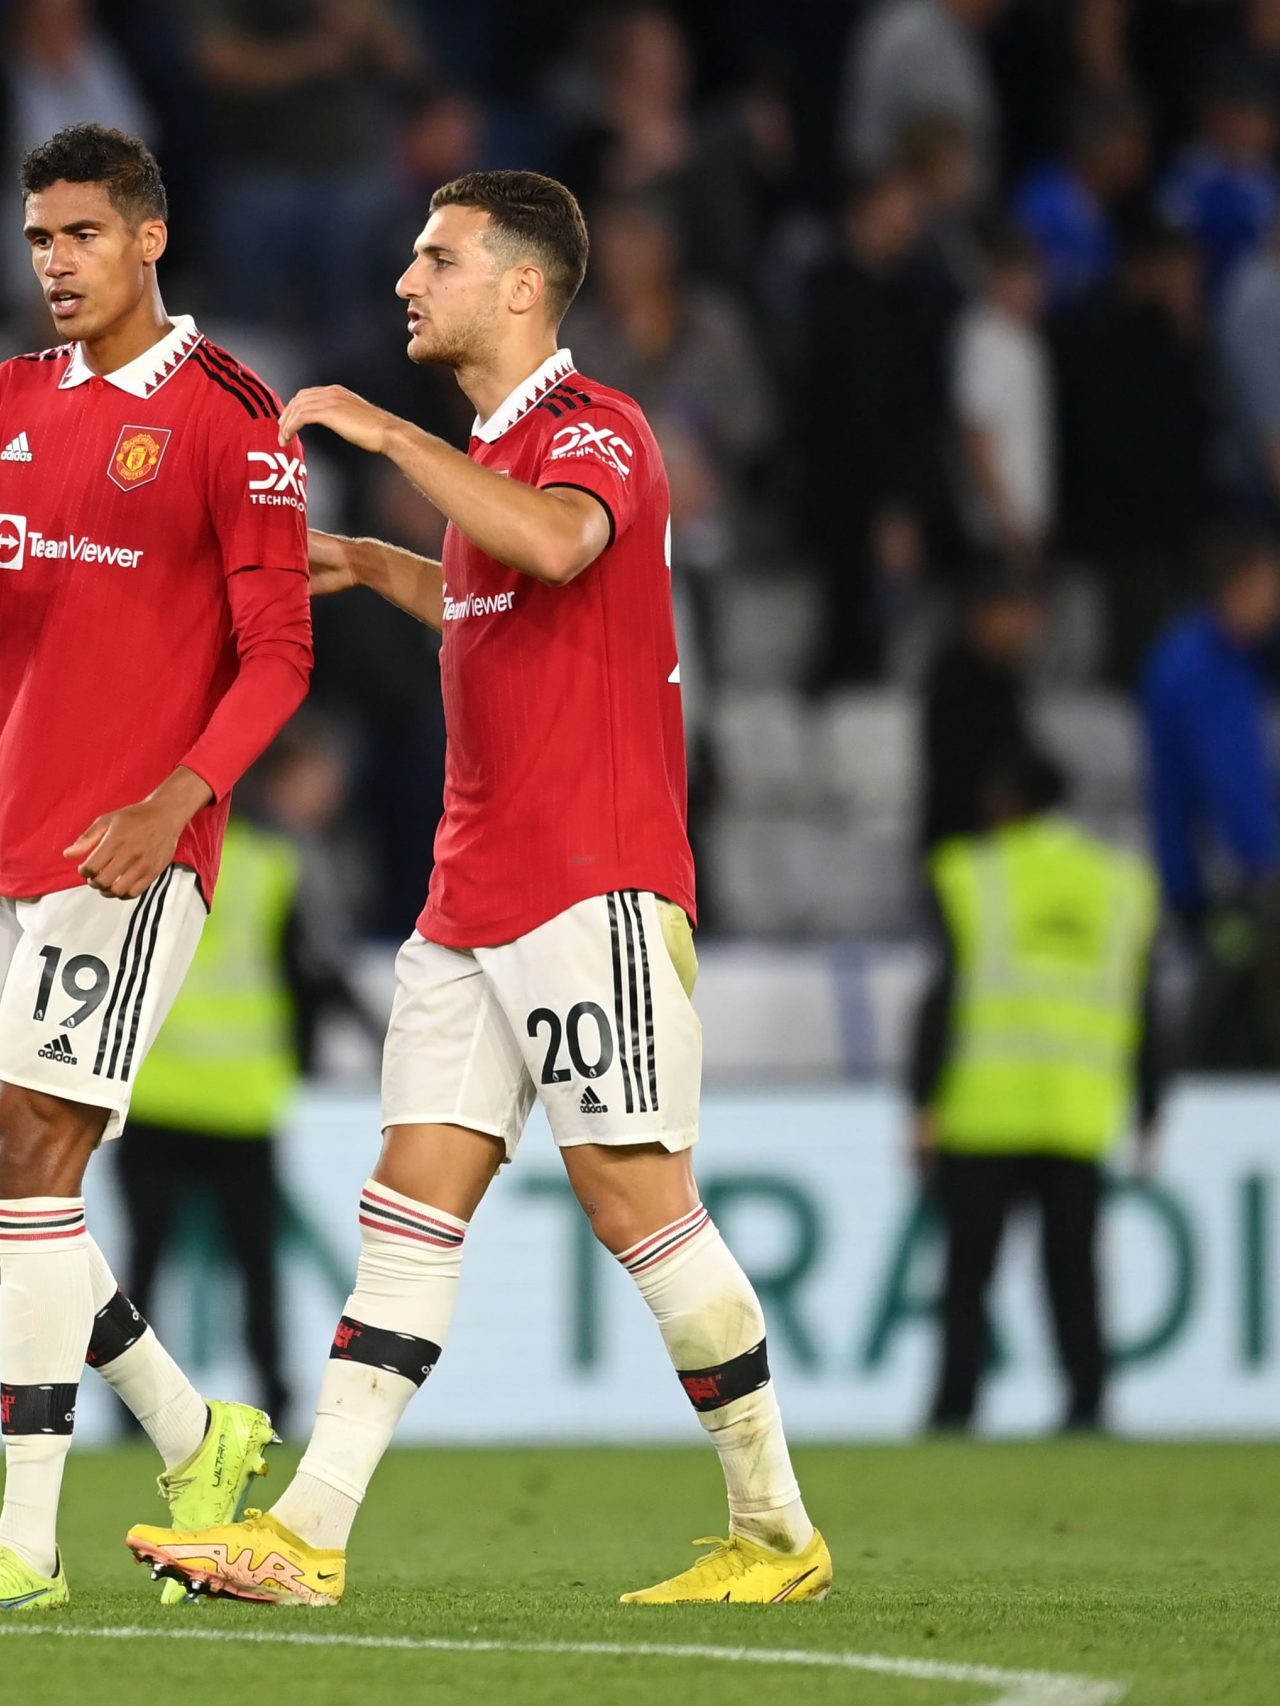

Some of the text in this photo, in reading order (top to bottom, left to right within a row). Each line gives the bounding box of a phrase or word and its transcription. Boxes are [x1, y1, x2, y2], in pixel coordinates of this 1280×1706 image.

[0, 448, 33, 462] adidas
[442, 591, 516, 621] TeamViewer
[32, 944, 111, 1029] 19
[37, 1048, 78, 1066] adidas
[526, 1001, 614, 1085] 20
